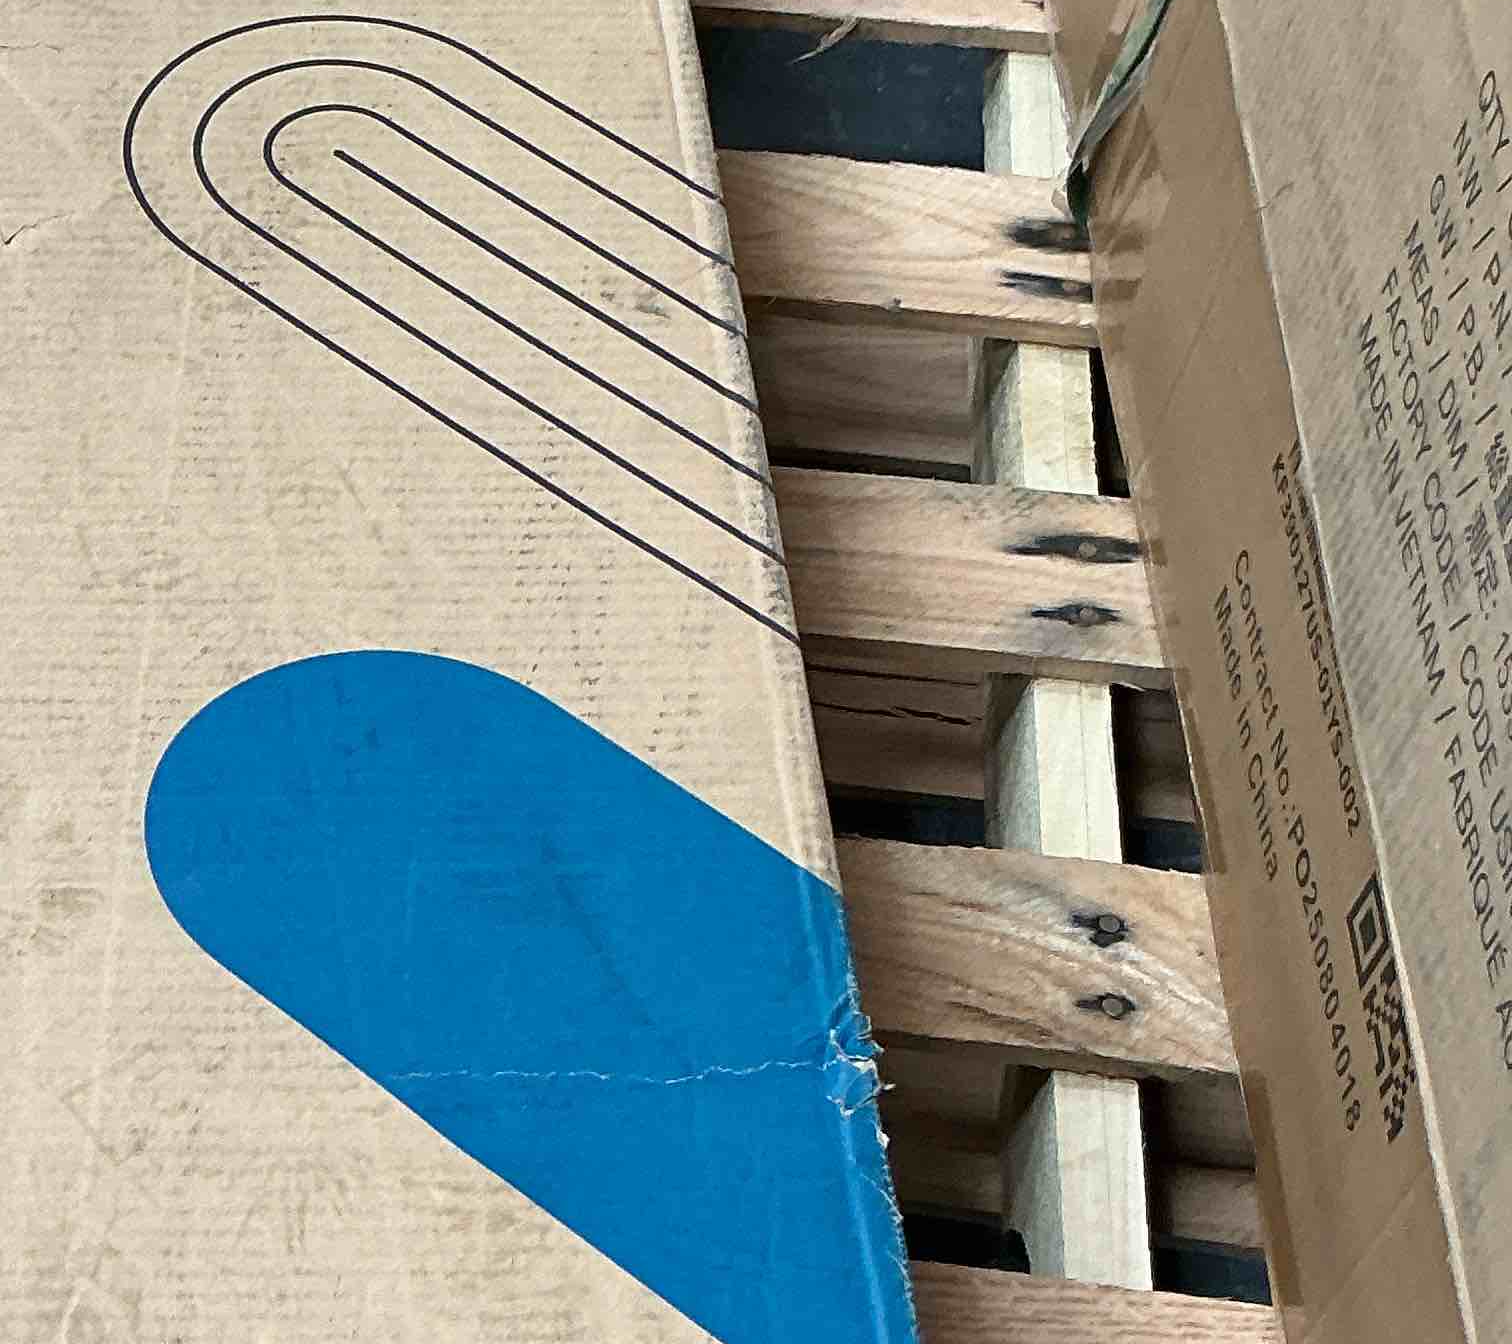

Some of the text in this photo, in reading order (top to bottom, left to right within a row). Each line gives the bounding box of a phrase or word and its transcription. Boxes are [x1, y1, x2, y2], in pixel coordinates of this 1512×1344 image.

[1479, 70, 1510, 158] QTY
[1405, 219, 1438, 346] MEAS
[1438, 378, 1468, 472] DIM
[1235, 550, 1278, 730] Contract
[1358, 312, 1392, 441] MADE
[1383, 438, 1405, 495] IN
[1395, 490, 1445, 696] VIETNAM
[1381, 266, 1432, 461] FACTORY
[1424, 472, 1460, 606] CODE
[1460, 644, 1499, 788] CODE
[1214, 584, 1278, 881] Made in China
